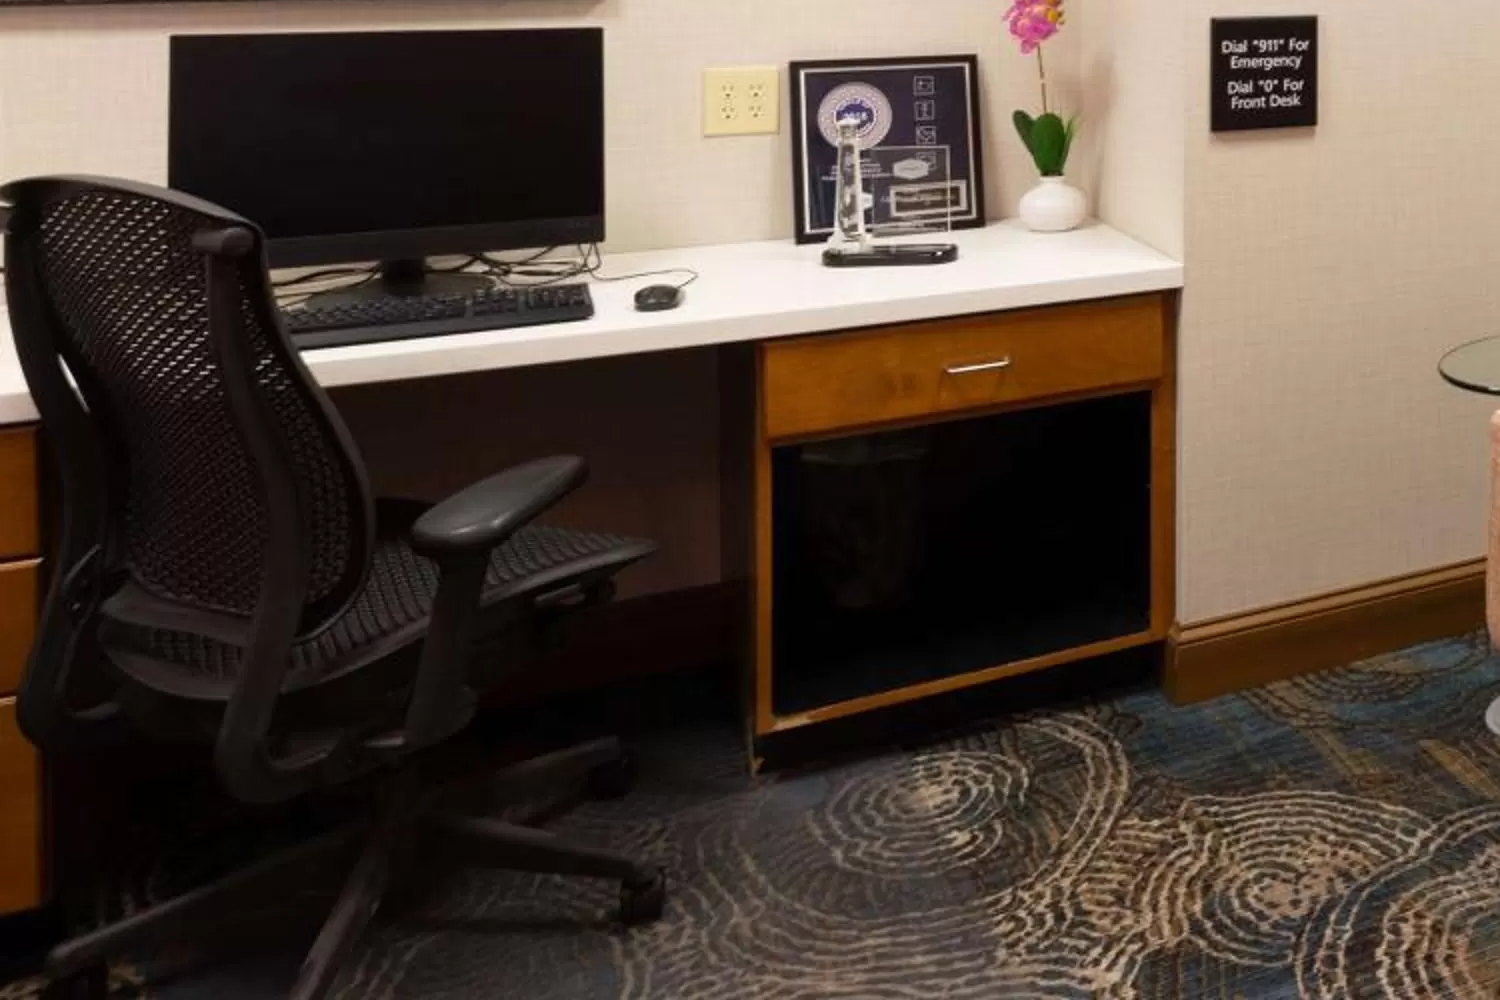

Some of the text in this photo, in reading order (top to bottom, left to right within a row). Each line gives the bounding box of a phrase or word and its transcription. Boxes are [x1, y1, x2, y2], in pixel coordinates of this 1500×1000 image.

[1221, 37, 1310, 54] Dial "911" For
[1230, 55, 1303, 71] Emergency
[1227, 80, 1253, 95] Dial
[1283, 78, 1304, 92] For
[1231, 93, 1301, 110] Front Desk
